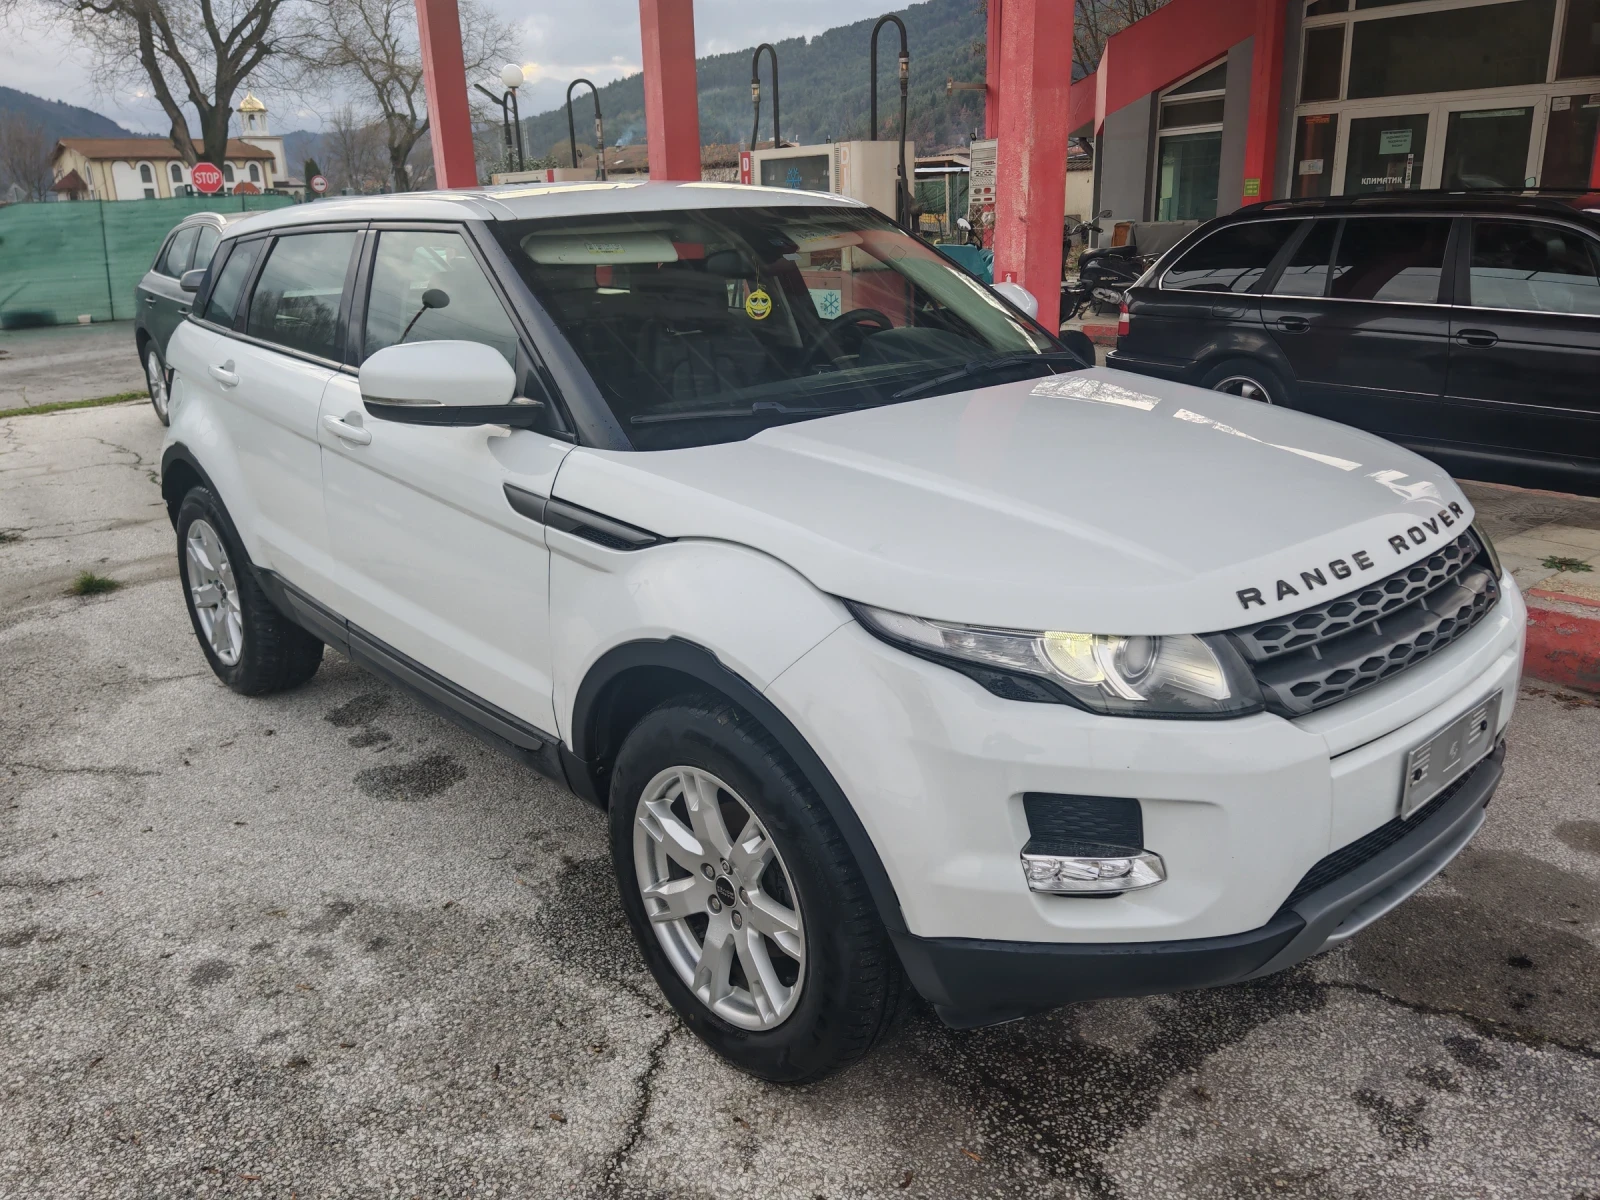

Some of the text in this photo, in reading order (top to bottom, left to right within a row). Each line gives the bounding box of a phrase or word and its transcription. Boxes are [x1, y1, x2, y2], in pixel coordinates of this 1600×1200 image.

[194, 172, 220, 184] STOP
[1361, 176, 1403, 185] КЛИМАТИК
[1236, 501, 1464, 610] RANGE ROVER
